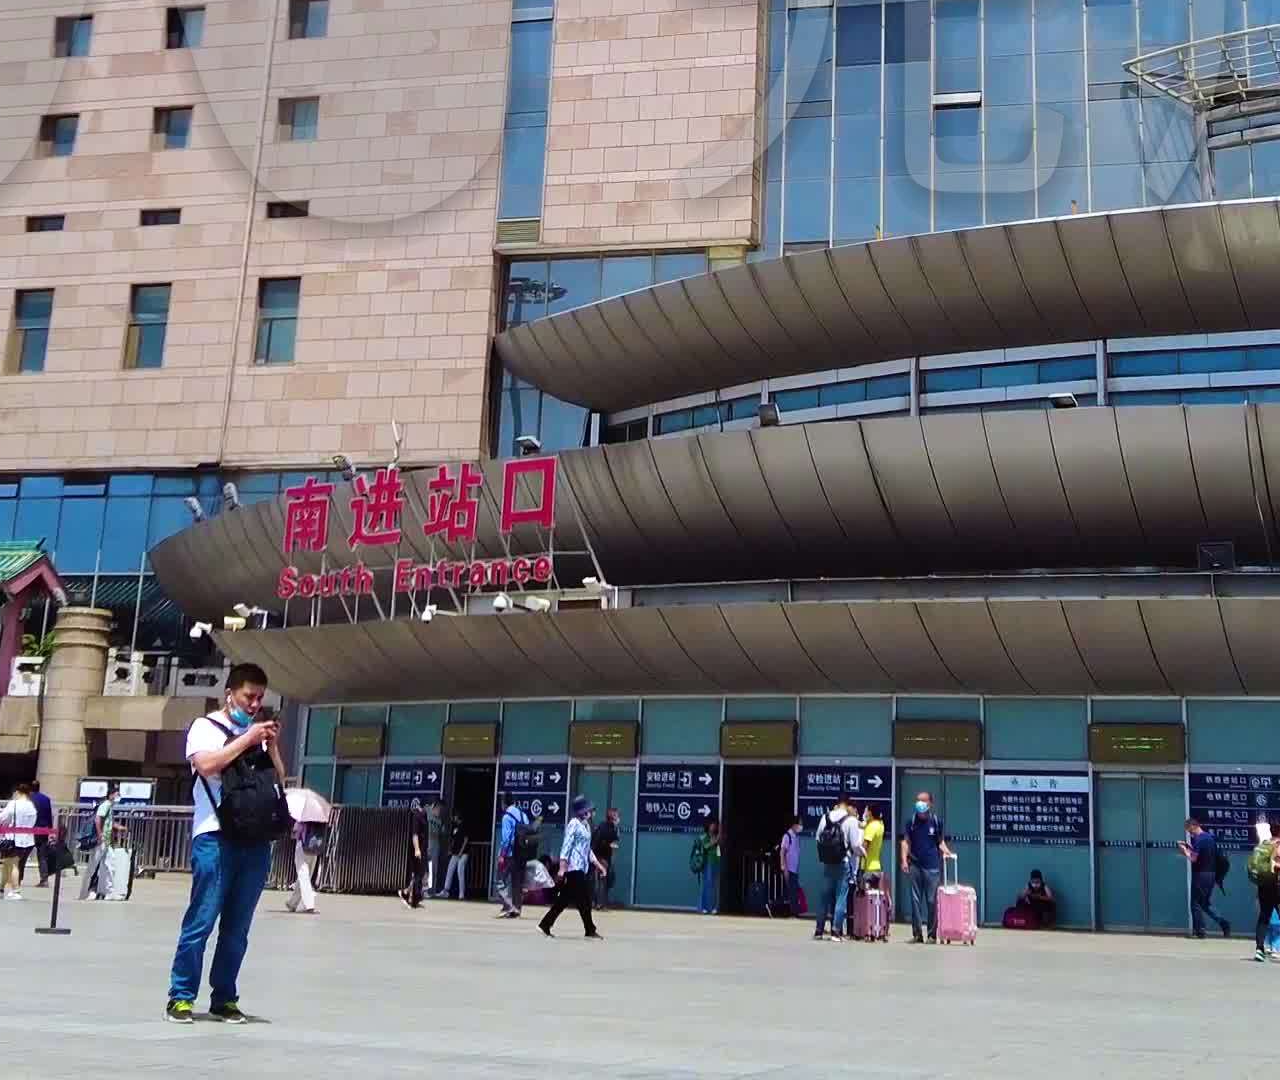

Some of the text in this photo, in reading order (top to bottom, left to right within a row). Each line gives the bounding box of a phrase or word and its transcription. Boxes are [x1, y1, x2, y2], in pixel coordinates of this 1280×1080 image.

[281, 456, 558, 553] 南进站口
[277, 555, 553, 599] South Entrance
[807, 773, 841, 785] 安检进站
